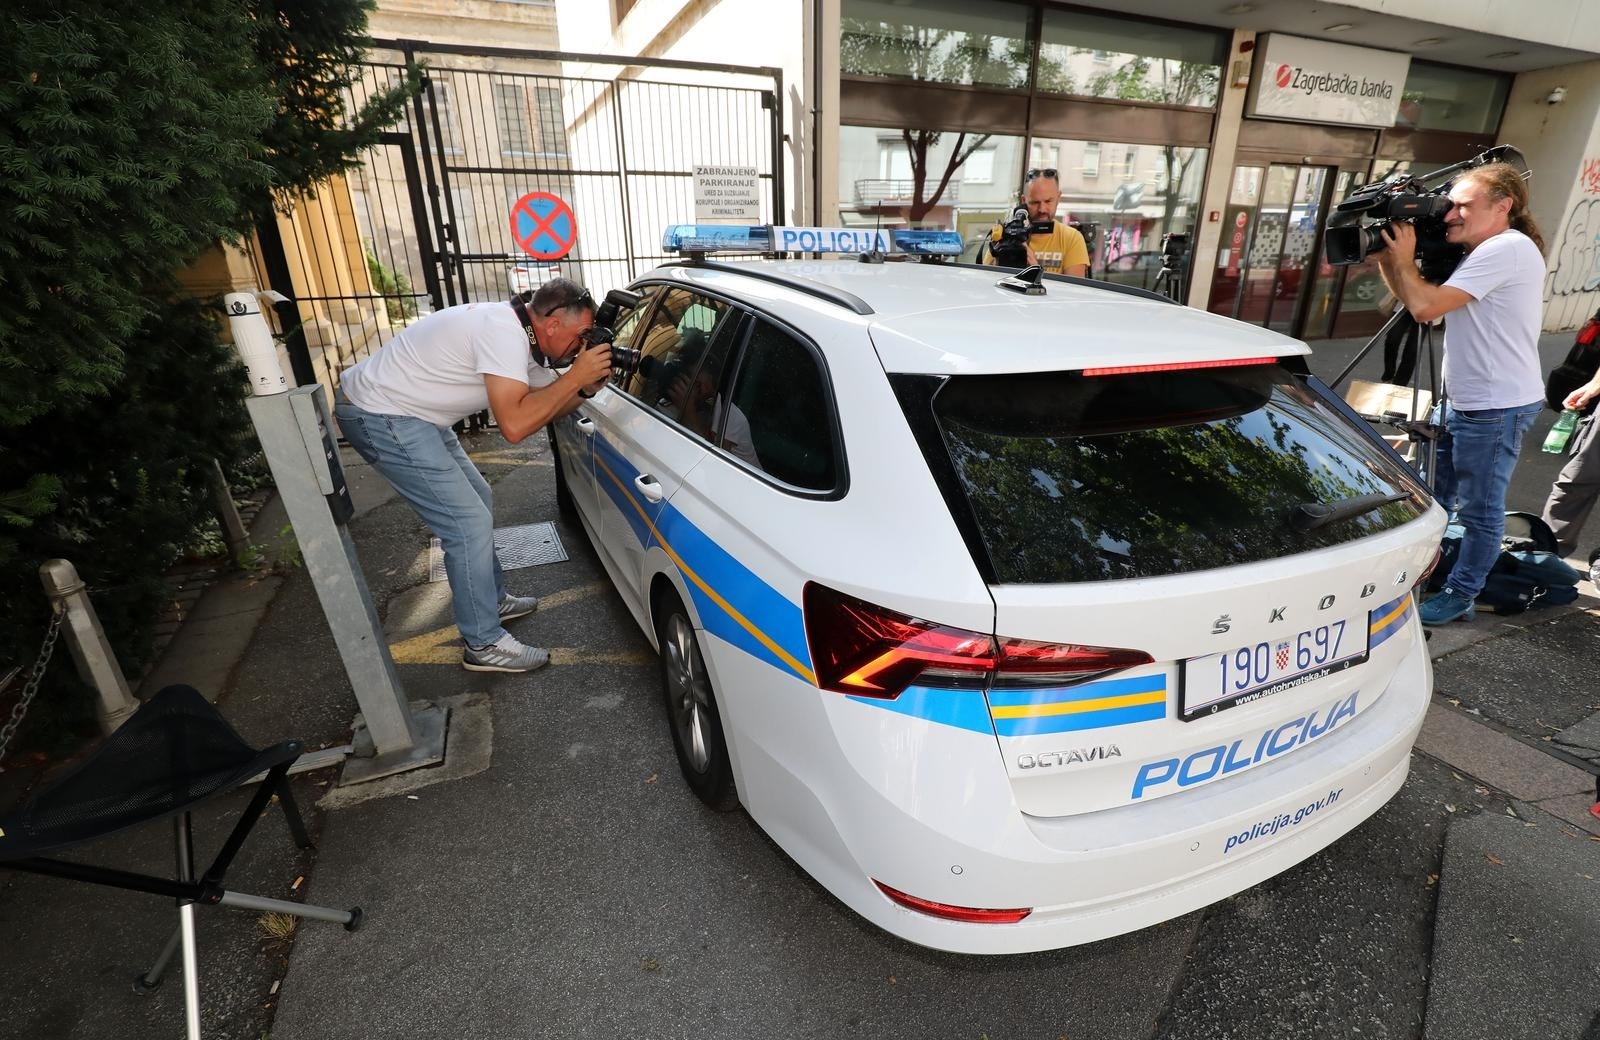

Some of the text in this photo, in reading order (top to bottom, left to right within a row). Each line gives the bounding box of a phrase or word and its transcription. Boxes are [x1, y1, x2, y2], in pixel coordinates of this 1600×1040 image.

[1292, 67, 1393, 99] Zagrebačka banka
[696, 167, 757, 177] ZABRANJENO
[699, 179, 755, 188] PARKIRANJE
[782, 230, 887, 252] POLICIJA
[525, 325, 537, 345] EOS
[1219, 619, 1346, 695] 190 697
[1235, 667, 1331, 706] www.autohrvatska.hr
[1017, 743, 1122, 770] OCTAVIA
[1131, 690, 1361, 800] POLICIJA
[1223, 787, 1344, 854] policija.gov.hr
